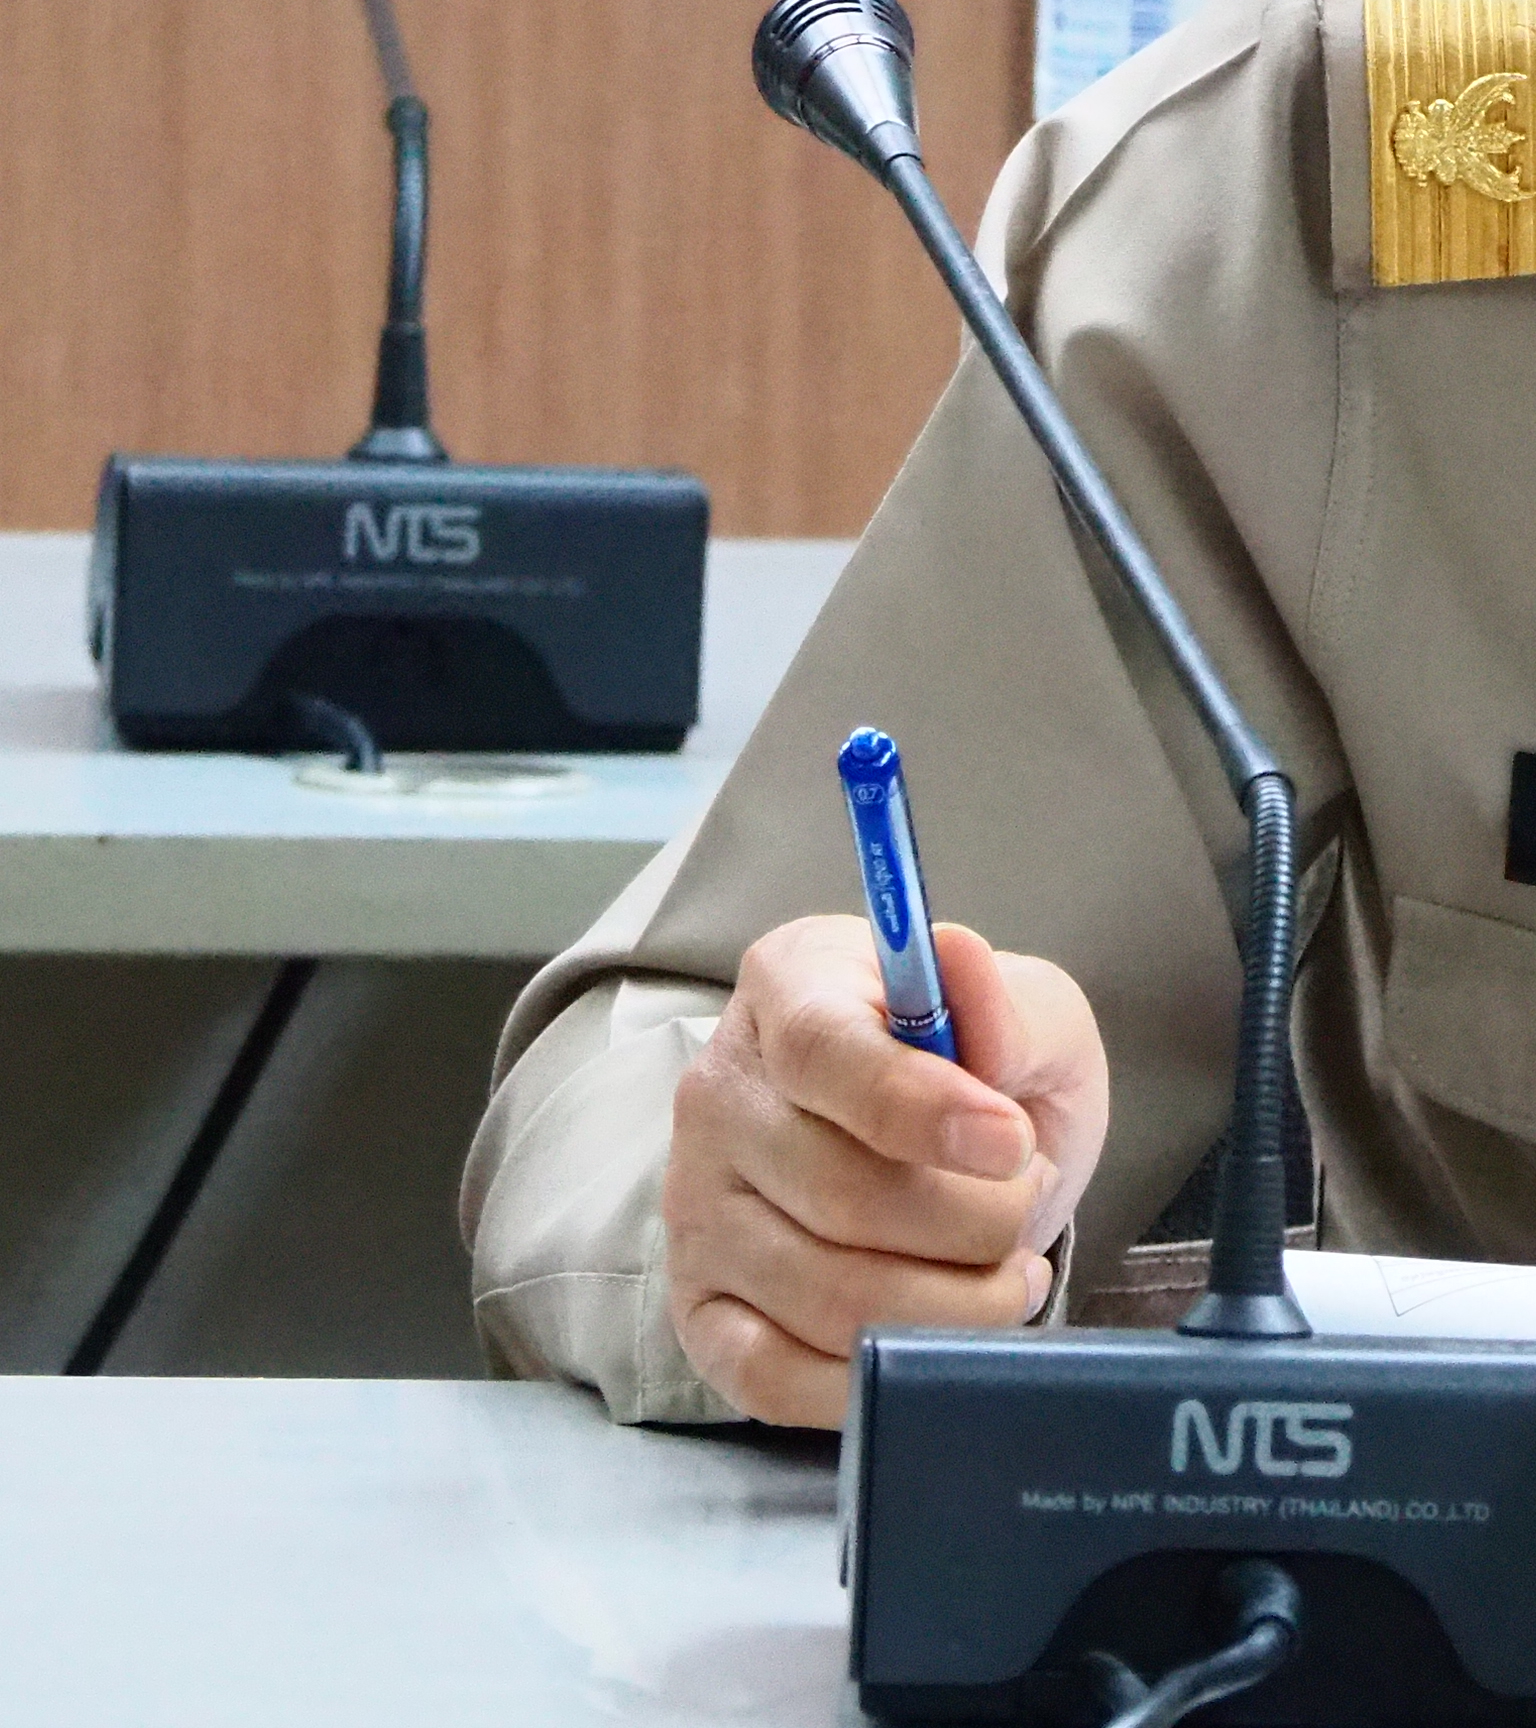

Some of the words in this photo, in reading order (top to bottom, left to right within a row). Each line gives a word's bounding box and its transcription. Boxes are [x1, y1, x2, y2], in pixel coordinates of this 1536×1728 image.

[1021, 1490, 1076, 1511] Made
[1083, 1492, 1107, 1515] by
[1163, 1493, 1273, 1517] INDUSTRY
